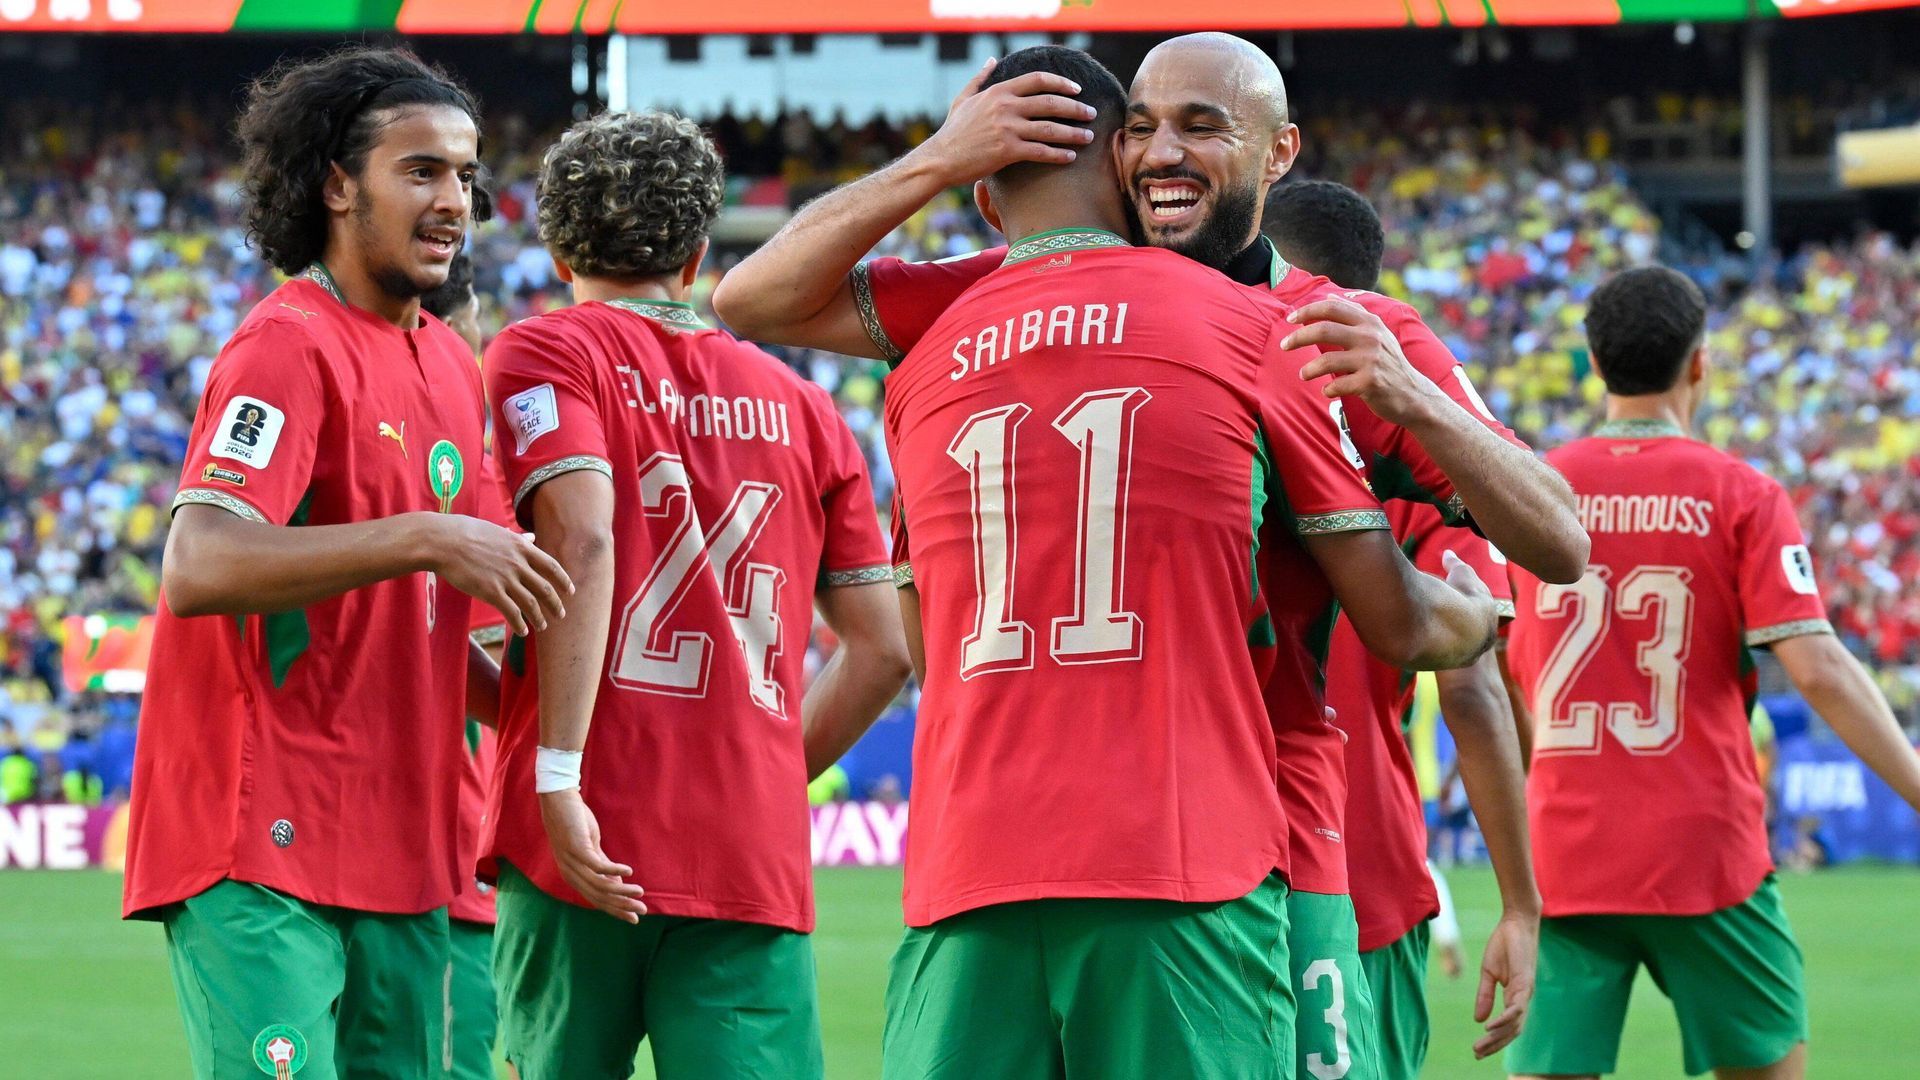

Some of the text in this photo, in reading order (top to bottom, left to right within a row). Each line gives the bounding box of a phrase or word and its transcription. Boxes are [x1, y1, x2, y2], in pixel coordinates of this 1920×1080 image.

[951, 303, 1128, 381] SAIBARI
[224, 445, 252, 459] 2026
[236, 433, 250, 443] FIFA
[659, 378, 790, 446] ANAOUI
[946, 387, 1153, 682] 11
[609, 451, 788, 721] 24
[1534, 563, 1695, 757] 23
[1303, 959, 1351, 1080] 3
